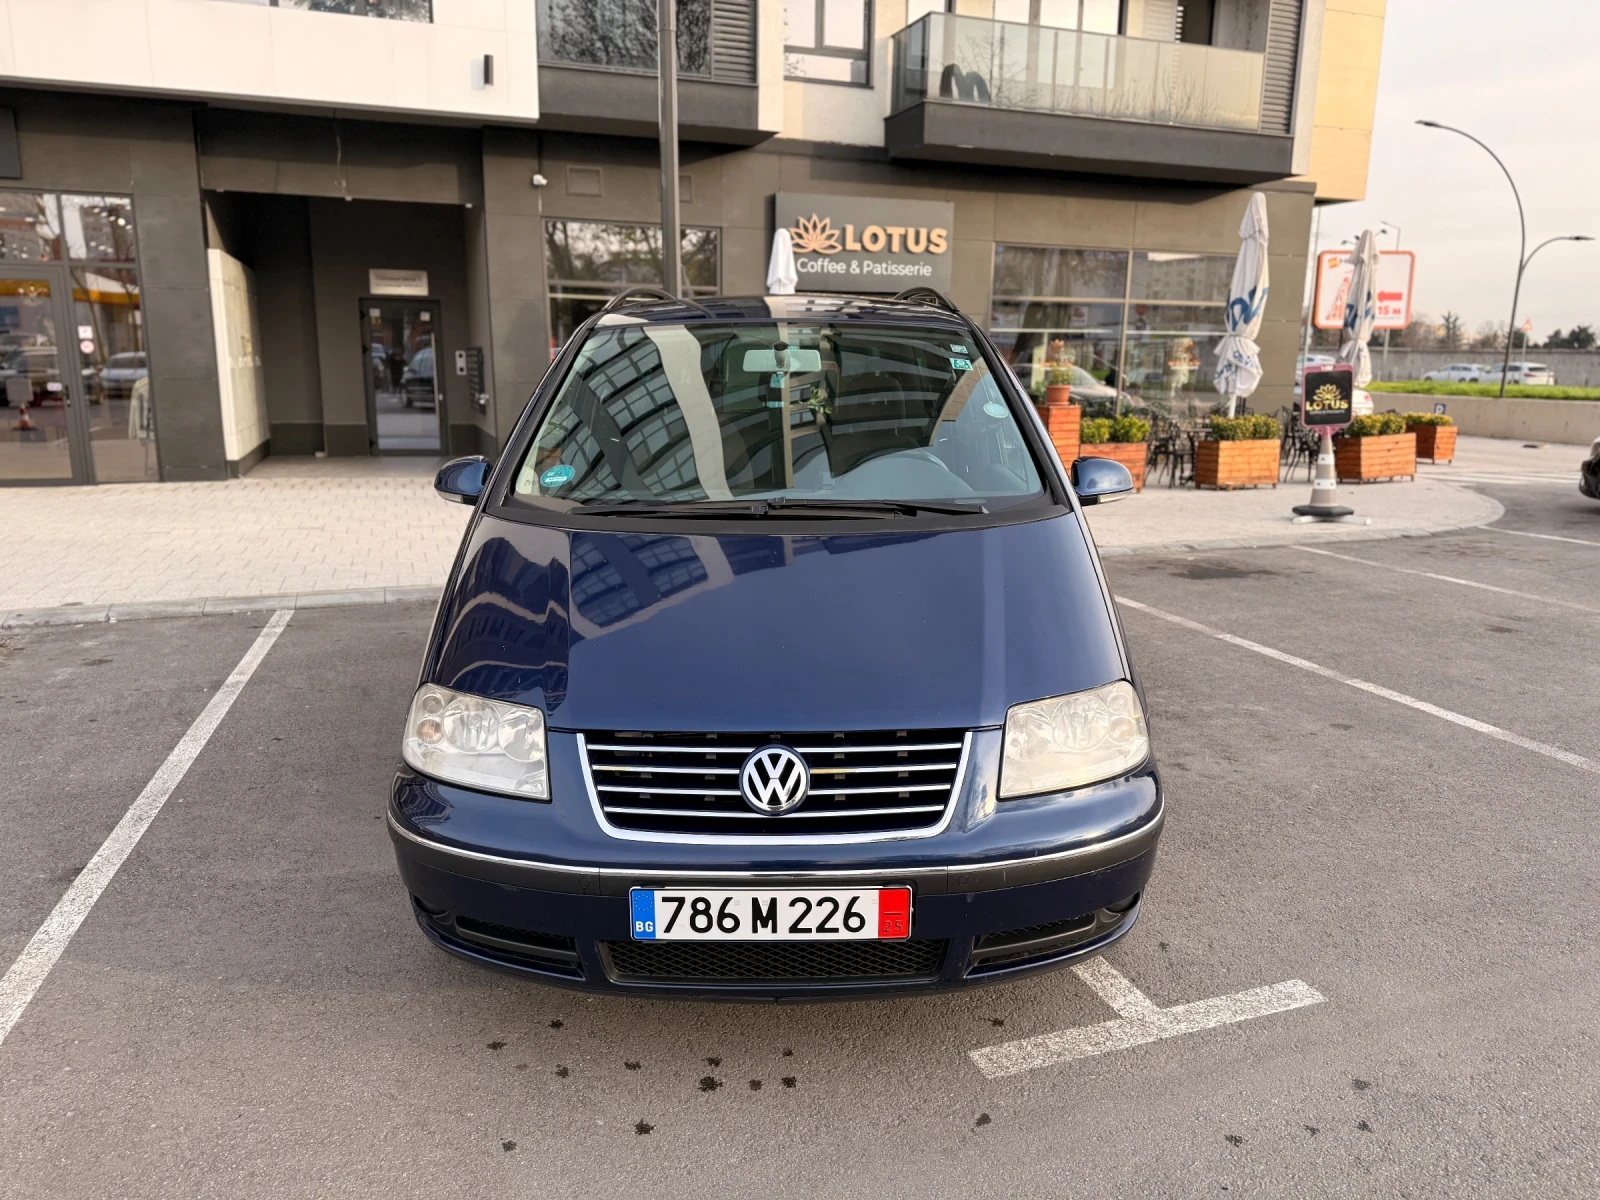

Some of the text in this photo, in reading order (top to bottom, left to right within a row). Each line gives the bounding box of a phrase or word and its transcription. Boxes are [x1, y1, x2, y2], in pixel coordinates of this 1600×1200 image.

[845, 224, 948, 254] LOTUS
[797, 257, 932, 276] Coffee & Patisserie
[1378, 305, 1390, 315] 15
[1305, 399, 1349, 411] LOTUS
[661, 896, 866, 934] 786 M 226
[635, 921, 654, 932] BG
[883, 920, 903, 933] 25
